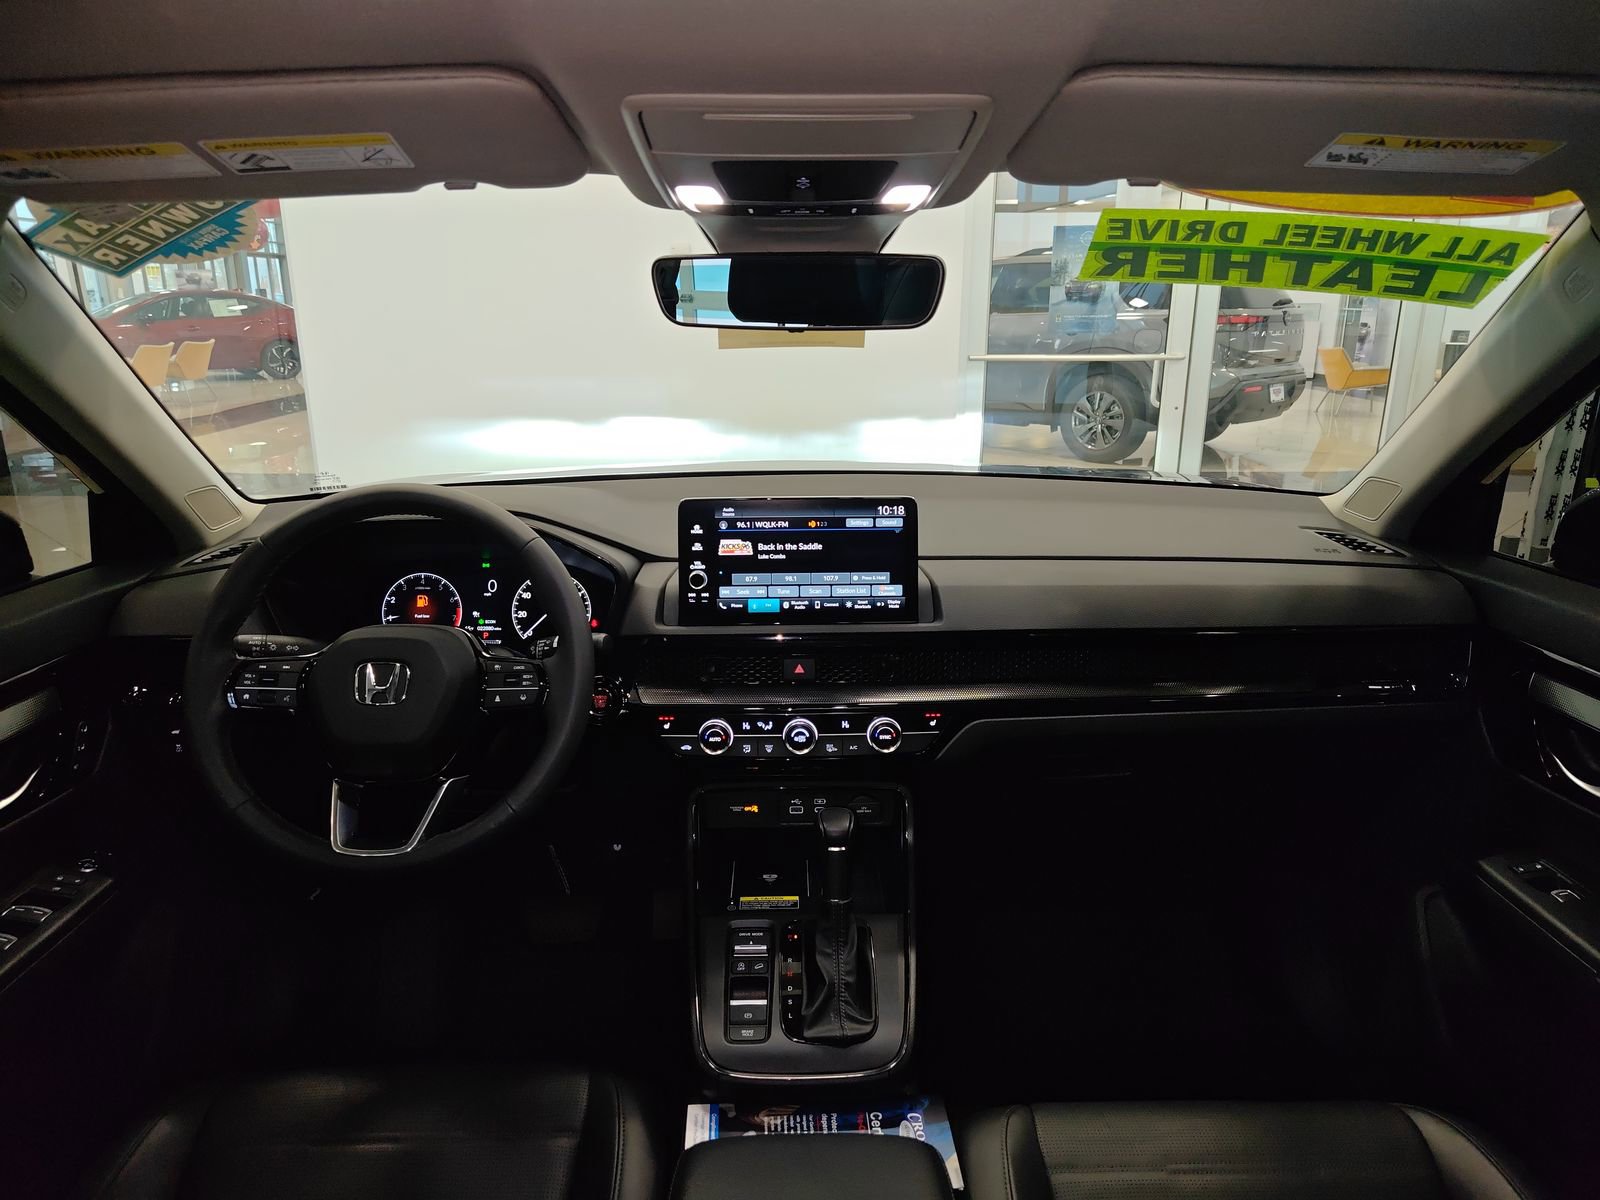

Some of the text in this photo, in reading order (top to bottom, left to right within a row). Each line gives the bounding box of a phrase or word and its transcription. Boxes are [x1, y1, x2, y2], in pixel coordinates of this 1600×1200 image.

[1403, 138, 1528, 151] WARNING
[32, 145, 156, 161] WARNING
[877, 505, 905, 516] 10:18
[736, 521, 789, 529] 96.1 WQLK-FM
[798, 542, 822, 550] Saddle
[488, 579, 497, 593] 0
[521, 591, 532, 599] 40
[390, 596, 396, 604] 2
[517, 610, 527, 618] 20
[483, 631, 489, 639] P
[906, 1112, 926, 1141] CRO
